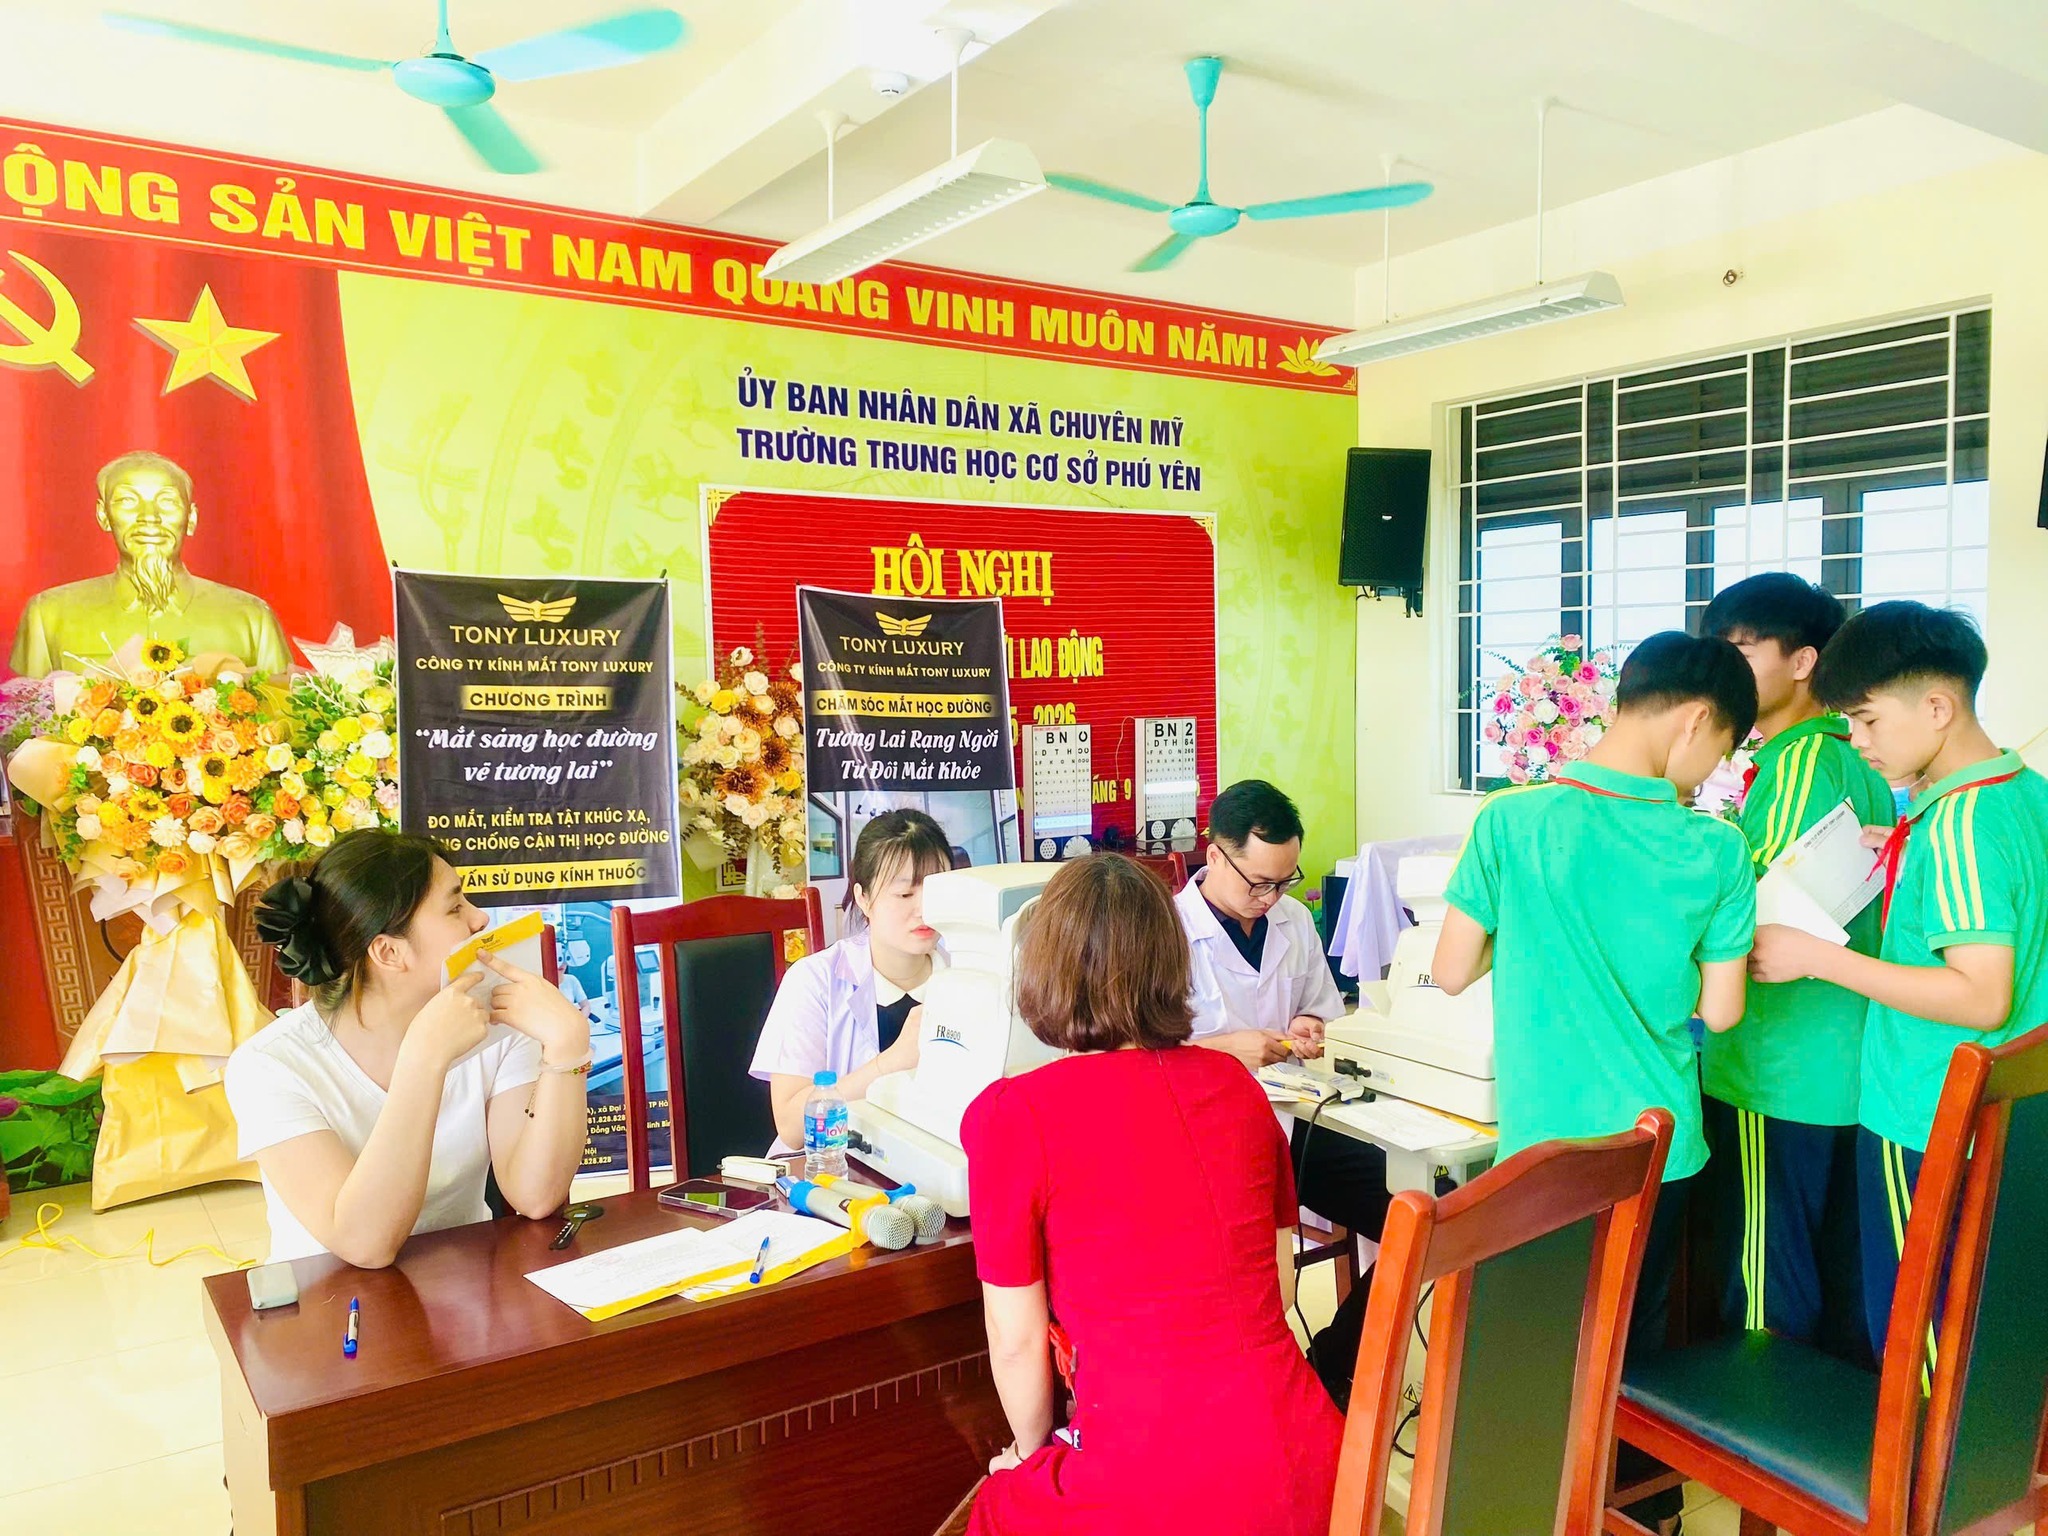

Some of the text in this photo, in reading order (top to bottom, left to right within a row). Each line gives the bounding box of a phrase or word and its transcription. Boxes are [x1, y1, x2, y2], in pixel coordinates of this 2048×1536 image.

[208, 176, 365, 251] SẢN
[388, 209, 531, 276] VIỆT
[551, 233, 692, 293] NAM
[712, 258, 889, 320] QUANG
[905, 286, 1014, 337] VINH
[1030, 305, 1155, 356] MUÔN
[1168, 322, 1267, 369] NĂM!
[737, 366, 1184, 447] ỦY BAN NHÂN DÂN XÃ CHUYÊN MỸ
[736, 424, 1201, 492] TRƯỜNG TRUNG HỌC CƠ SỞ PHÚ YÊN
[957, 550, 1054, 606] NGHỊ
[450, 625, 621, 647] TONY LUXURY
[840, 636, 965, 656] TONY LUXURY
[416, 655, 654, 673] CÔNG TY KÍNH MẮT TONY LUXURY
[1019, 637, 1053, 679] LAO
[1058, 629, 1104, 684] ĐỘNG
[817, 660, 991, 678] CÔNG TY KÍNH MẮT TONY LUXURY
[470, 690, 607, 707] CHƯƠNG TRÌNH
[816, 695, 992, 717] CHĂM SÓC MẮT HỌC ĐƯỜNG
[479, 727, 538, 752] sáng
[542, 729, 582, 753] học
[586, 728, 658, 751] đường
[816, 728, 999, 753] Tương Lai Rạng Ngời
[1185, 722, 1193, 736] 2
[464, 761, 492, 782] vẽ
[494, 761, 562, 785] tương
[841, 759, 982, 780] Từ Đôi Mắt Khỏe
[1124, 778, 1132, 800] 9
[427, 815, 450, 830] ĐO
[454, 808, 487, 831] MẮT,
[491, 807, 524, 828] KIỂM
[528, 812, 553, 827] TRA
[556, 808, 580, 828] TẬT
[585, 807, 623, 825] KHÚC
[466, 832, 520, 851] CHỐNG
[524, 833, 555, 852] CẬN
[559, 834, 580, 851] THỊ
[584, 832, 617, 852] HỌC
[619, 829, 670, 846] ĐƯỜNG
[492, 868, 511, 886] SỬ
[515, 871, 555, 889] DỤNG
[560, 867, 593, 883] KÍNH
[598, 862, 646, 881] THUỐC
